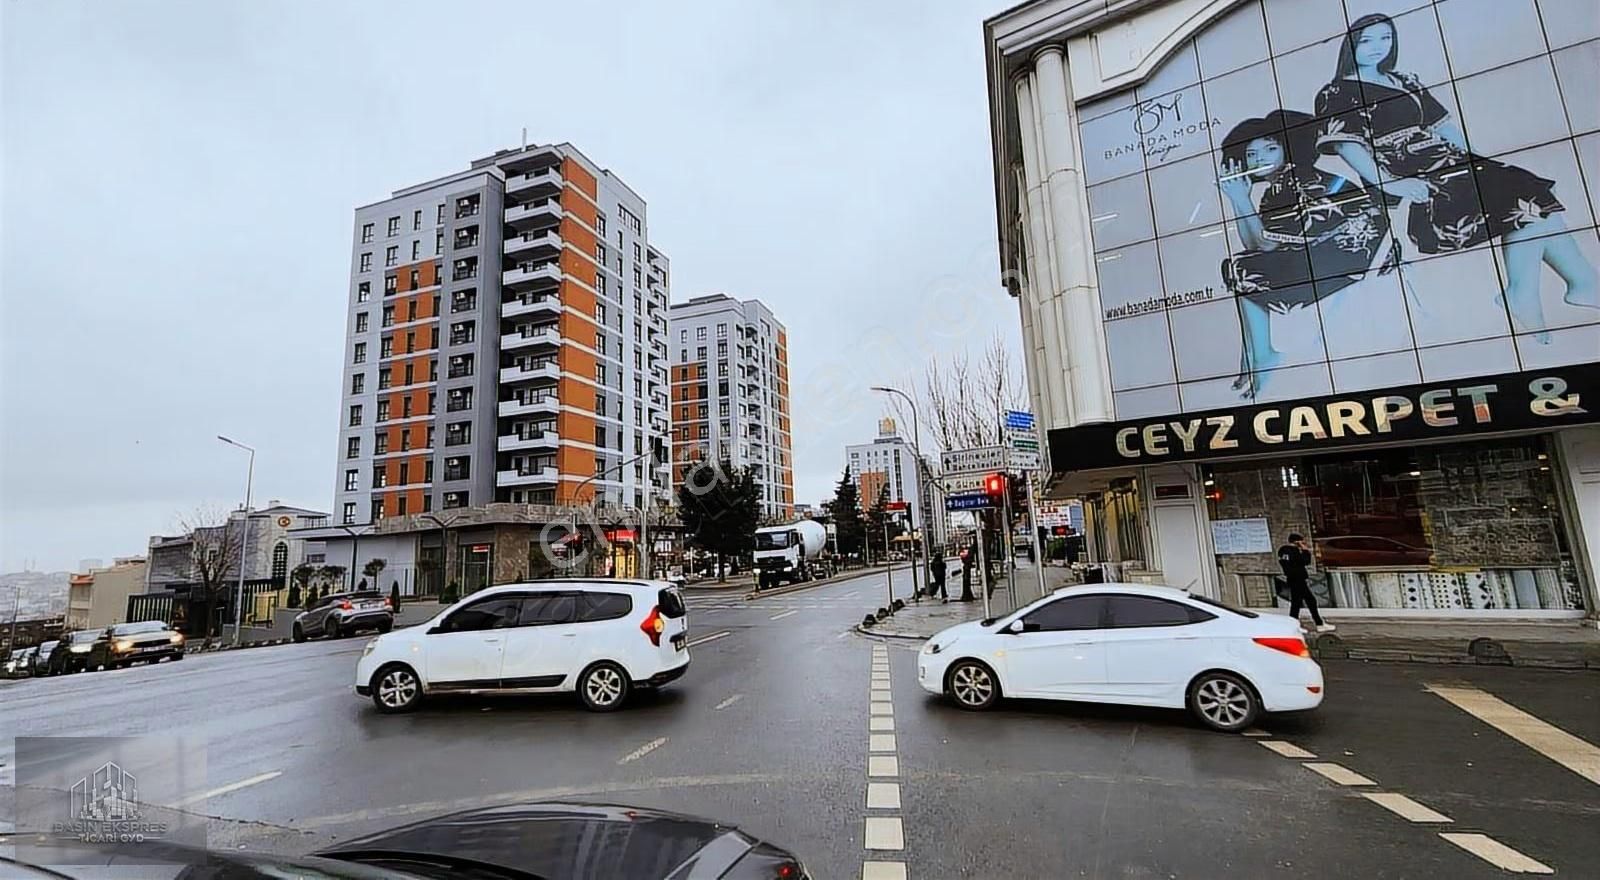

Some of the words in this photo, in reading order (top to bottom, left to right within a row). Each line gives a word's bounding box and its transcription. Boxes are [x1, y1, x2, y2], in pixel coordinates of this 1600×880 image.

[1103, 134, 1167, 160] BANADA
[1172, 117, 1222, 139] MODA
[1105, 286, 1214, 318] www.banadamoda.com.tr
[1116, 416, 1239, 458] CEYZ
[1253, 384, 1498, 444] CARPET
[1529, 376, 1588, 417] &
